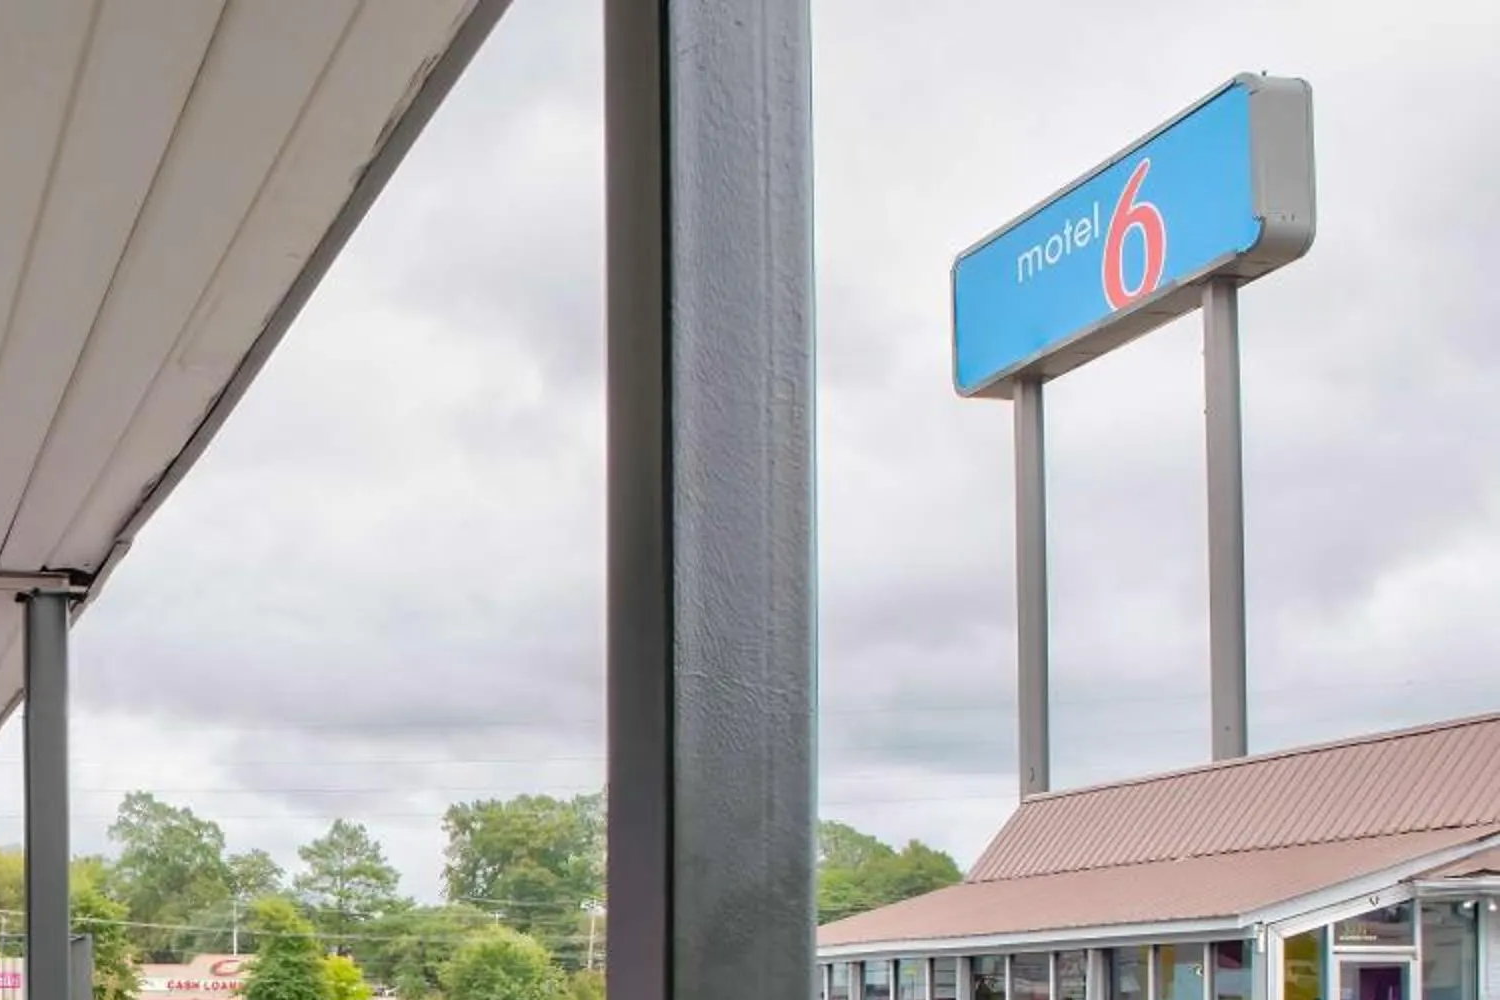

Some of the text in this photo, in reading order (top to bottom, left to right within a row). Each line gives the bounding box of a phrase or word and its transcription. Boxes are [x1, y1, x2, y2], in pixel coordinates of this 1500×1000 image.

[1017, 157, 1167, 312] motel 6
[167, 979, 200, 991] CASH
